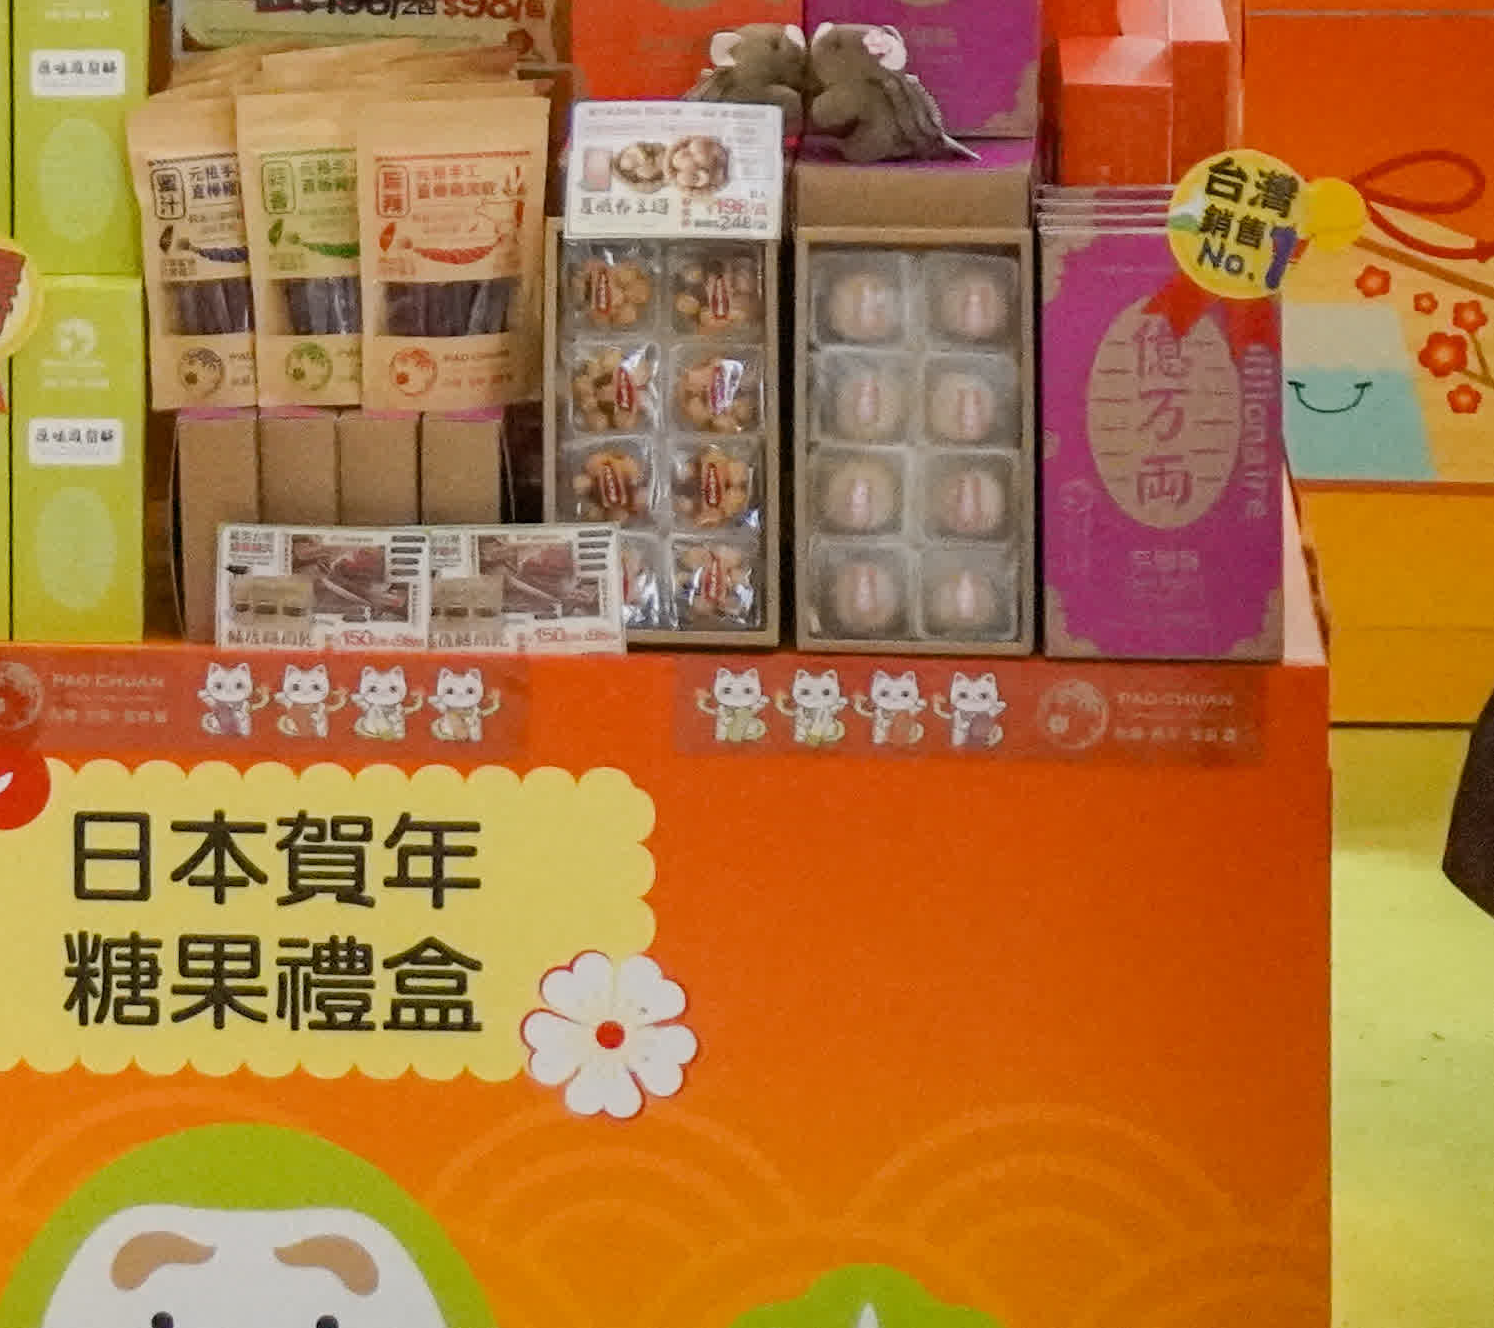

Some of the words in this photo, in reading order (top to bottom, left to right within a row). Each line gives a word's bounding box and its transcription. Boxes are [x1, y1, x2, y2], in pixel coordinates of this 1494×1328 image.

[1199, 204, 1262, 253] 銷售
[1202, 157, 1299, 221] 台灣
[71, 810, 483, 910] 日本賀年
[63, 931, 484, 1033] 糖果禮盒
